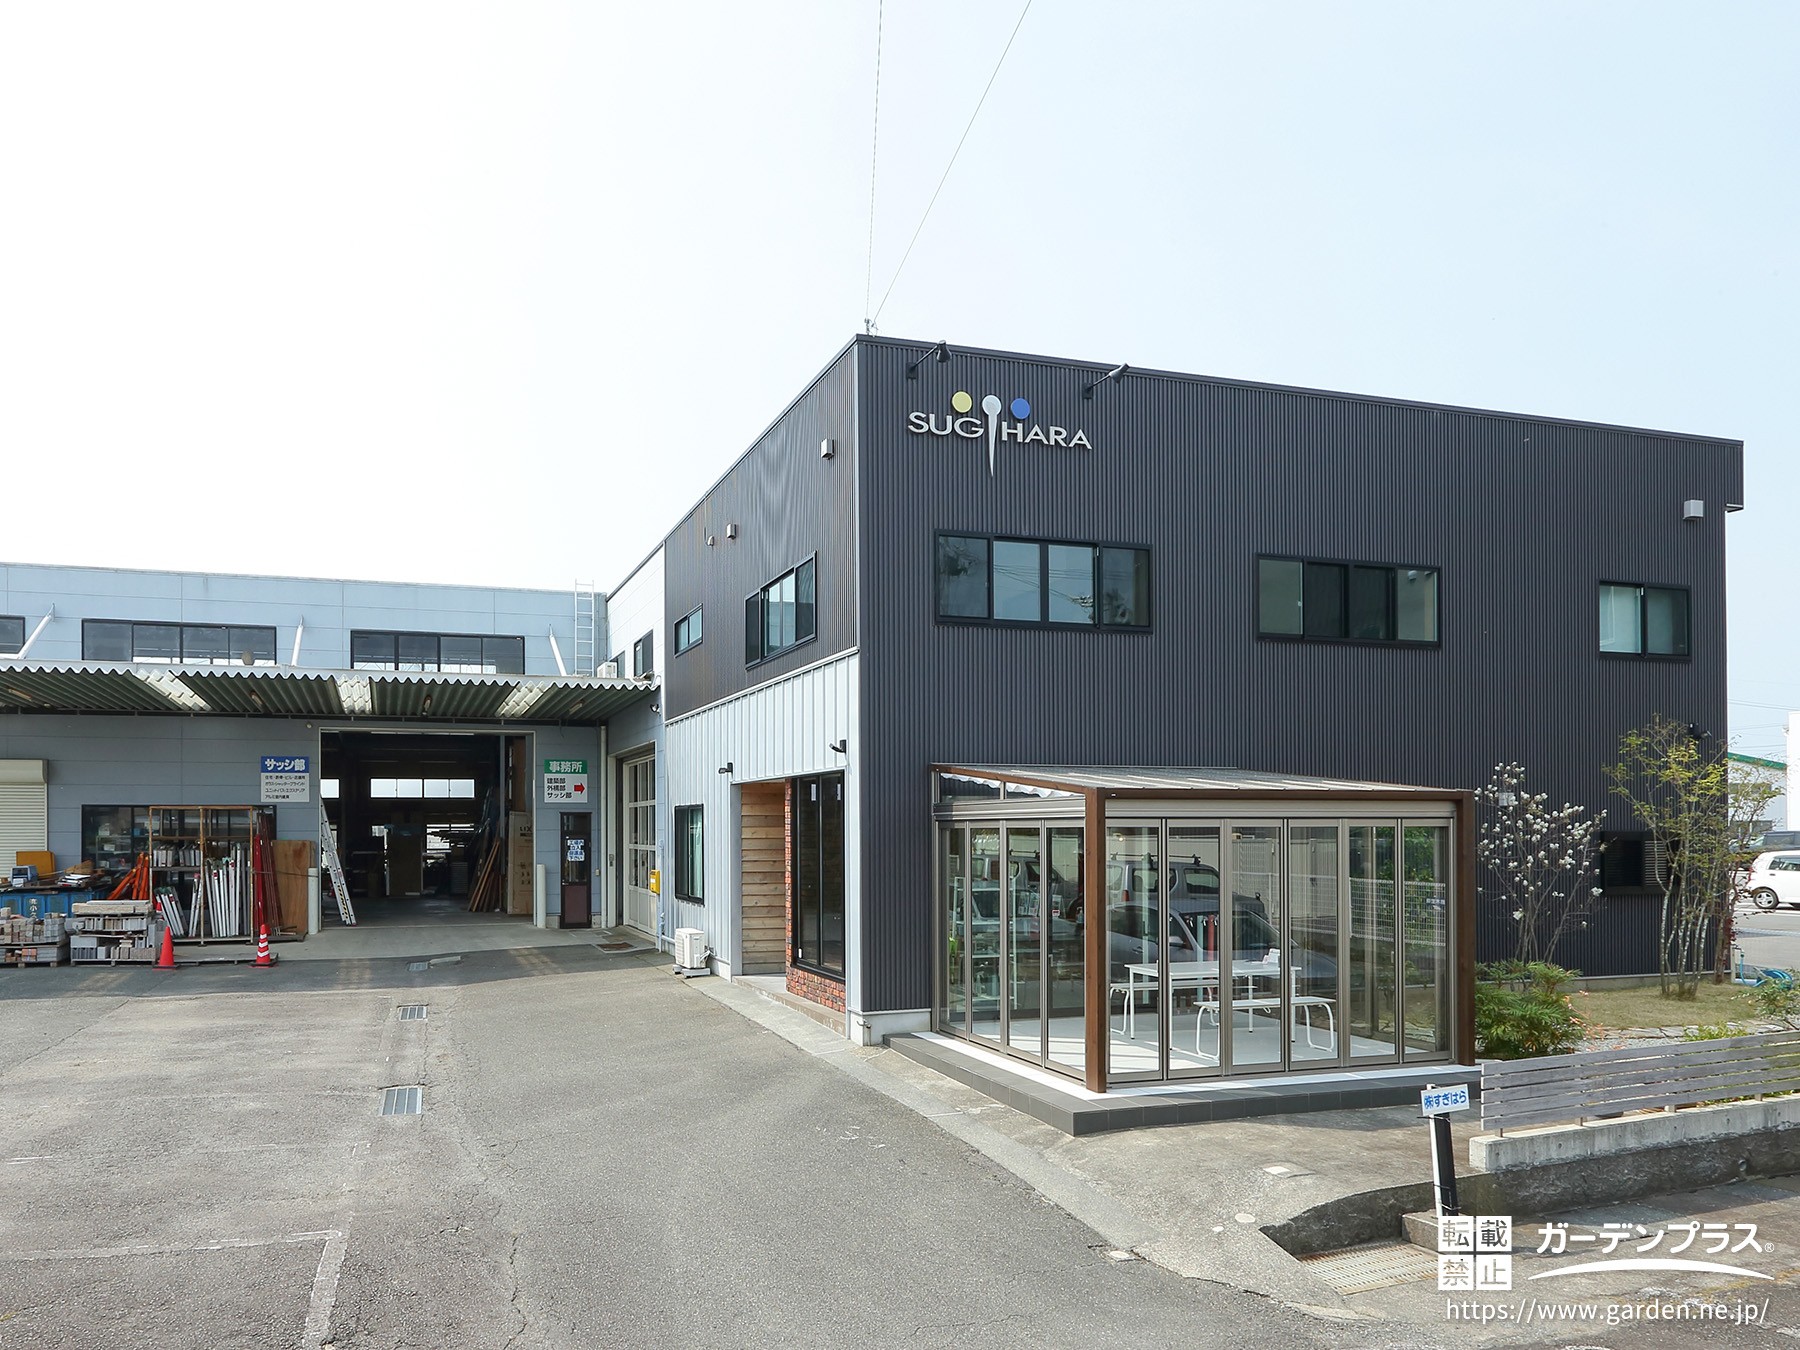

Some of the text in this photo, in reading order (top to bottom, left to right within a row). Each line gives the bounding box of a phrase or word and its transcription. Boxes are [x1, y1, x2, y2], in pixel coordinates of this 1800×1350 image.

[264, 758, 306, 771] サッシ部
[549, 760, 583, 773] 事務所
[547, 791, 573, 799] サッシ部
